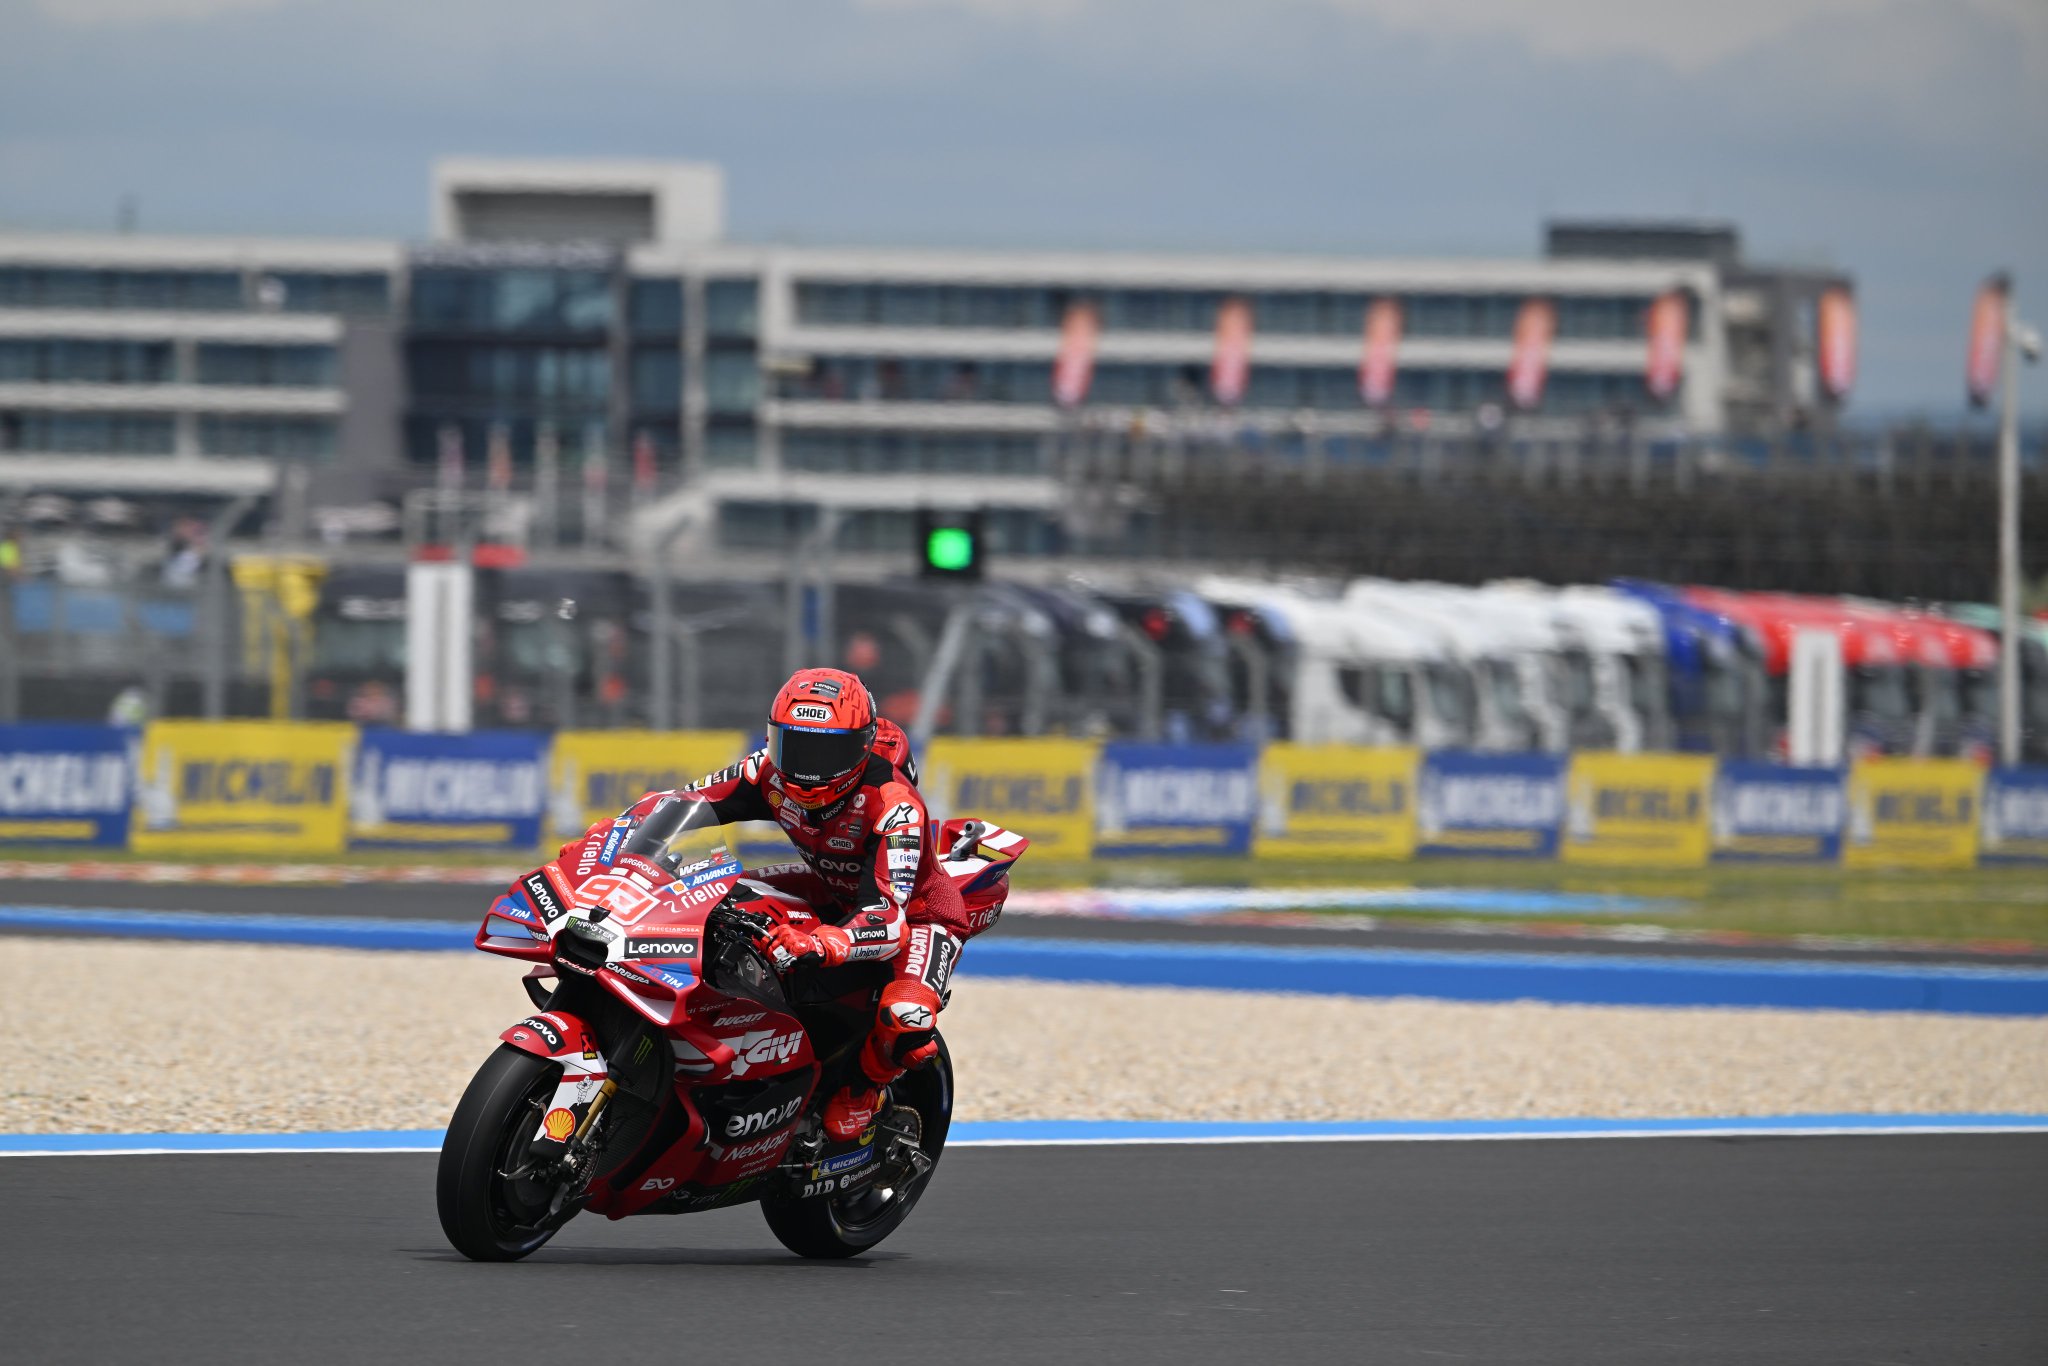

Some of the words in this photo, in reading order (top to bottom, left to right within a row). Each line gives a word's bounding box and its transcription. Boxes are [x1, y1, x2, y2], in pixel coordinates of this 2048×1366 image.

[796, 707, 827, 720] SHOEI
[795, 772, 820, 781] Insta360
[821, 800, 845, 820] Lenovo
[601, 829, 620, 862] ADVANCE
[831, 840, 852, 849] SHOEI
[576, 842, 601, 876] riello
[680, 860, 709, 876] WRS
[692, 864, 736, 887] ADVANCE
[527, 874, 558, 919] Lenovo
[681, 882, 729, 909] riello
[509, 907, 530, 920] TIM
[855, 929, 886, 939] Lenovo
[628, 941, 694, 954] Lenovo
[854, 946, 882, 958] Unipol
[904, 928, 929, 977] DUCATI
[605, 962, 650, 985] CARRERA
[932, 941, 951, 990] Lenovo
[661, 973, 684, 989] TIM
[713, 1012, 768, 1027] DUCATI
[744, 1030, 804, 1064] GIVI
[723, 1130, 790, 1162] NetApp
[831, 1151, 870, 1170] MICHELIN
